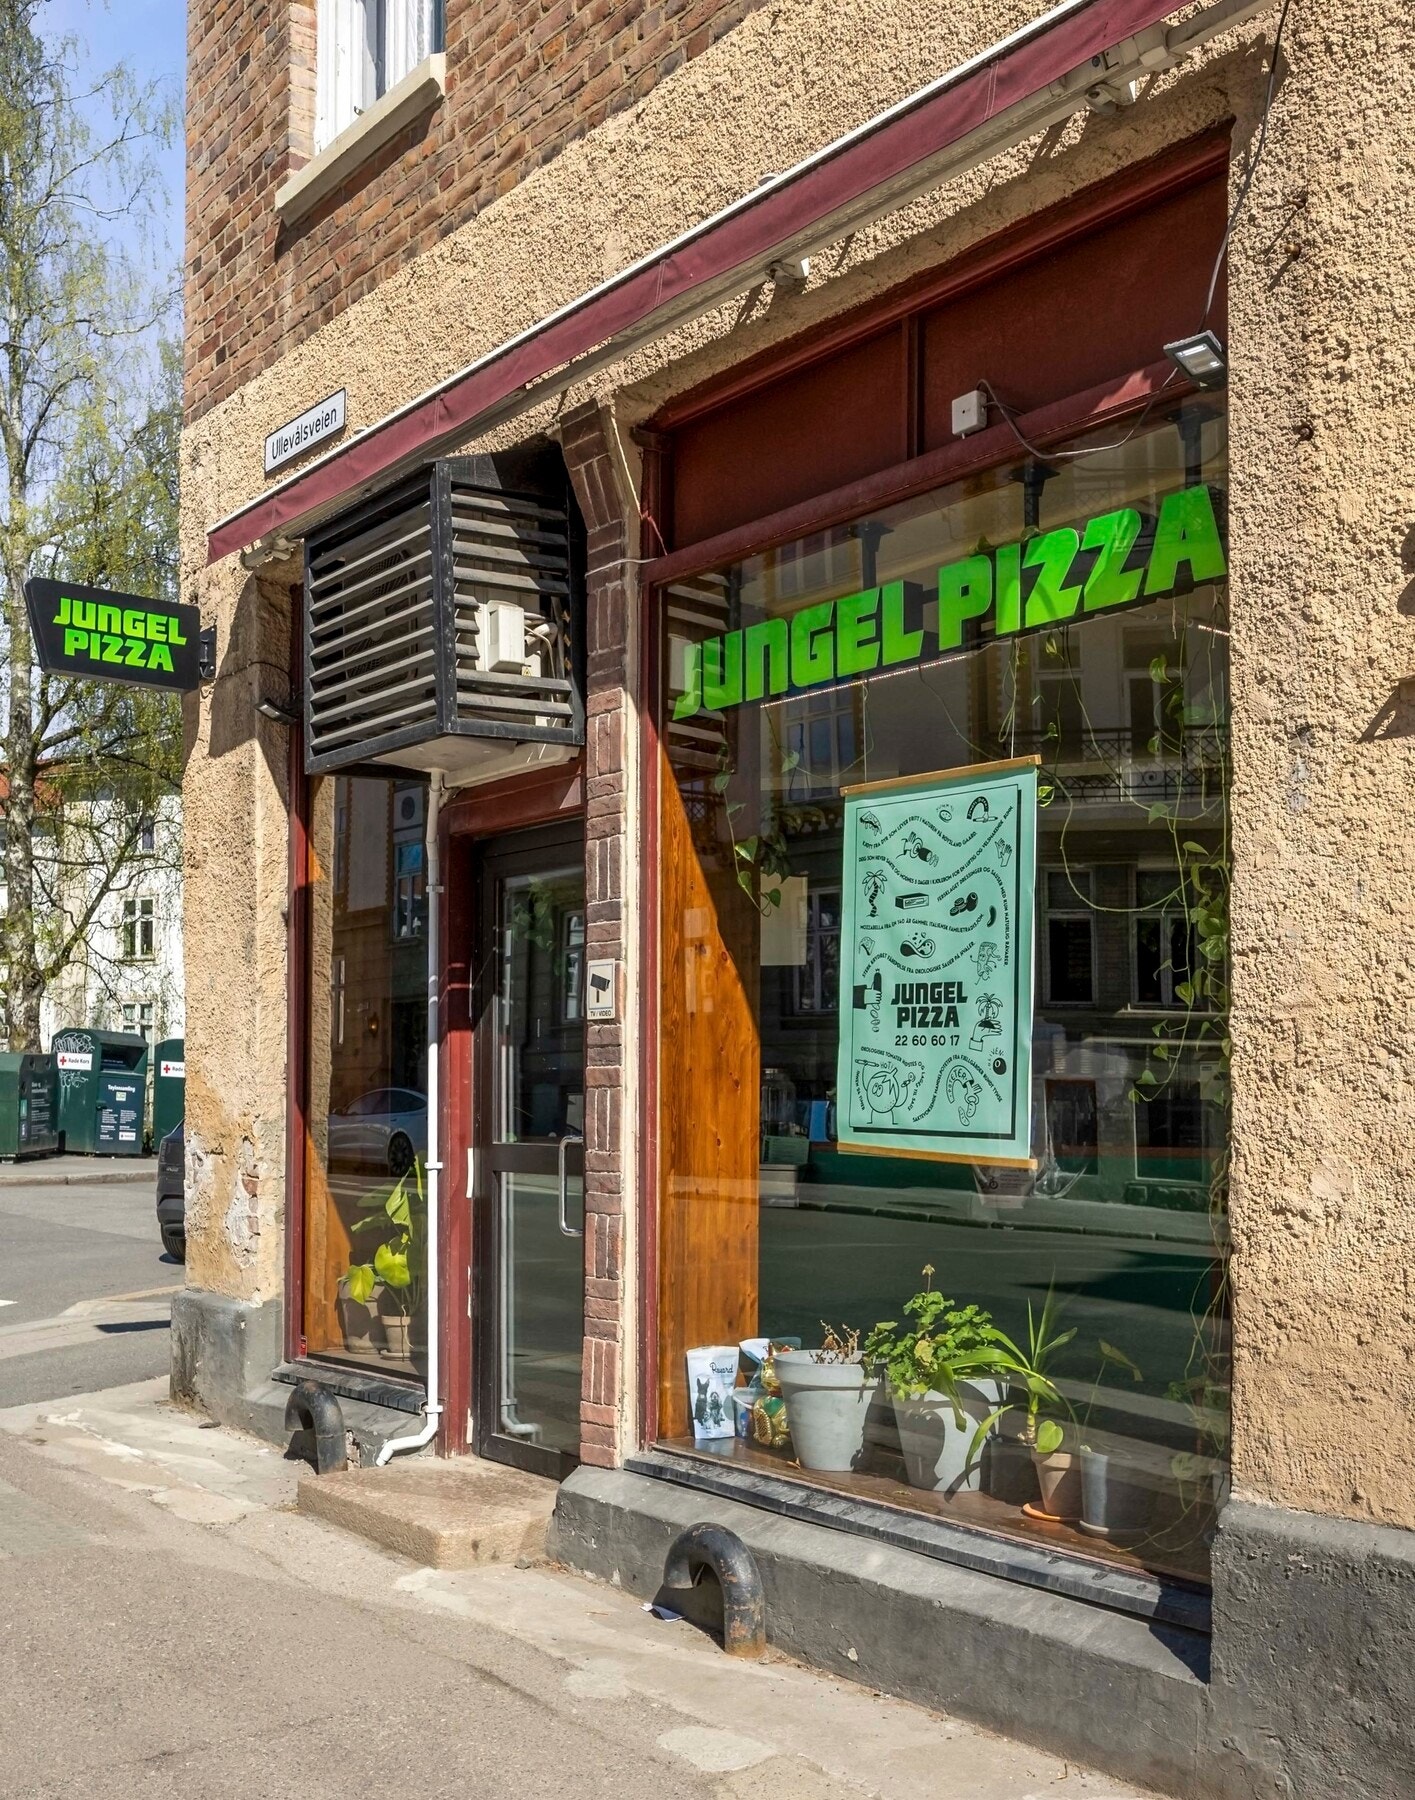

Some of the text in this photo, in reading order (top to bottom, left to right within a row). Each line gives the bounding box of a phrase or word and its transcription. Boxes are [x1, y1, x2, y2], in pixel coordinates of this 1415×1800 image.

[272, 408, 337, 460] Ullevålsveien
[672, 484, 1226, 720] JUNGEL PIZZA
[53, 598, 188, 646] JUNGEL
[64, 628, 174, 672] PIZZA
[888, 830, 898, 838] SOM
[976, 848, 983, 856] OG
[891, 982, 968, 1005] JUNGEL
[897, 1006, 960, 1028] PIZZA
[895, 1035, 960, 1046] 22 60 60 17
